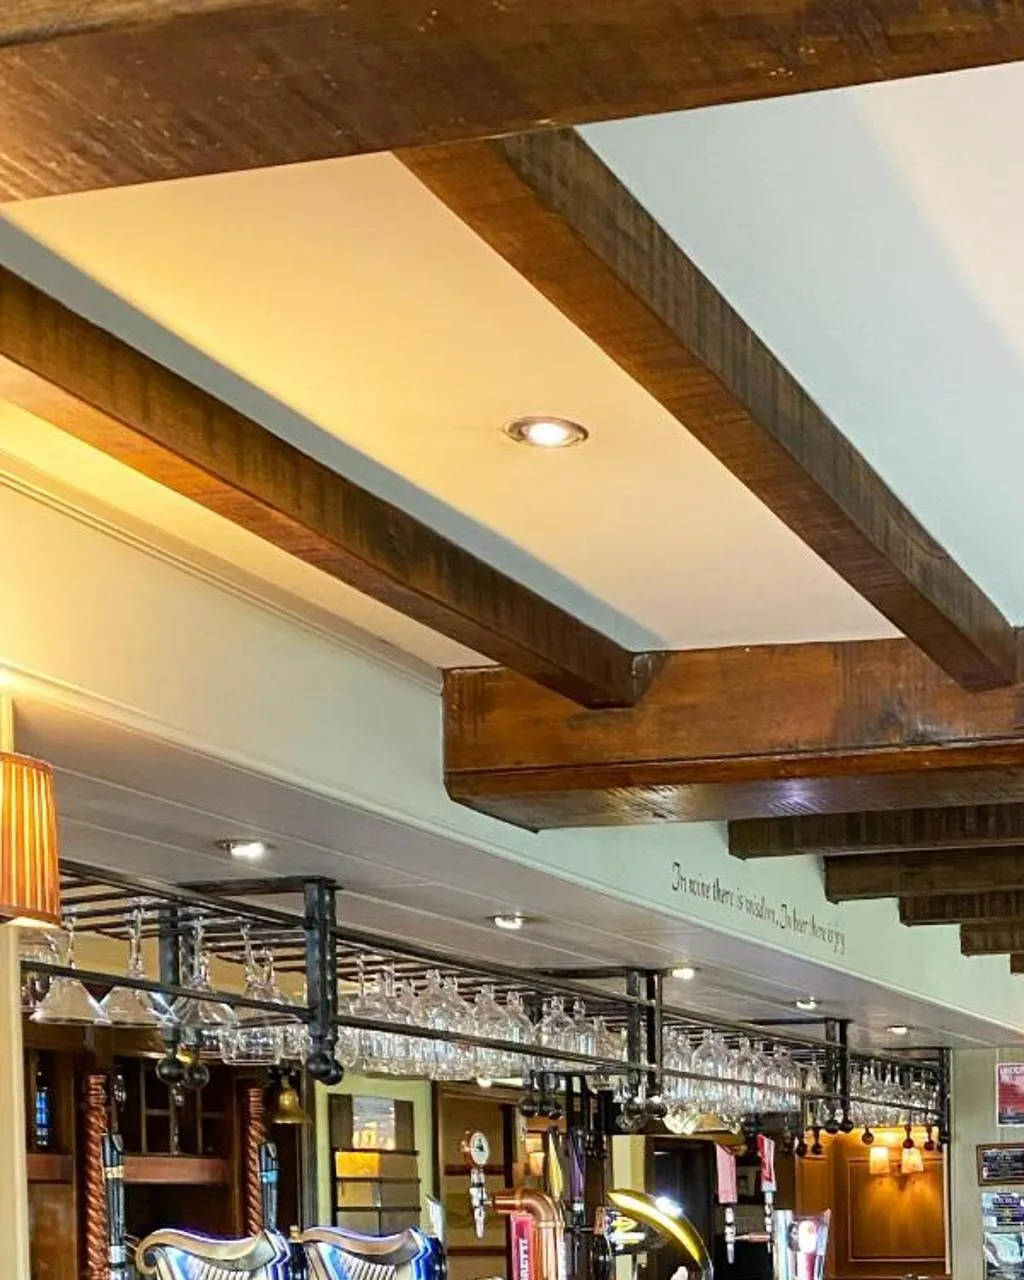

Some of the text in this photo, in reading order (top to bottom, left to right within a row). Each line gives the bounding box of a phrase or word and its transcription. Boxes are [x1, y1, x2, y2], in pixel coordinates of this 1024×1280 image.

[671, 861, 687, 892] In
[689, 873, 711, 900] wine
[712, 877, 735, 908] there
[736, 886, 744, 911] is
